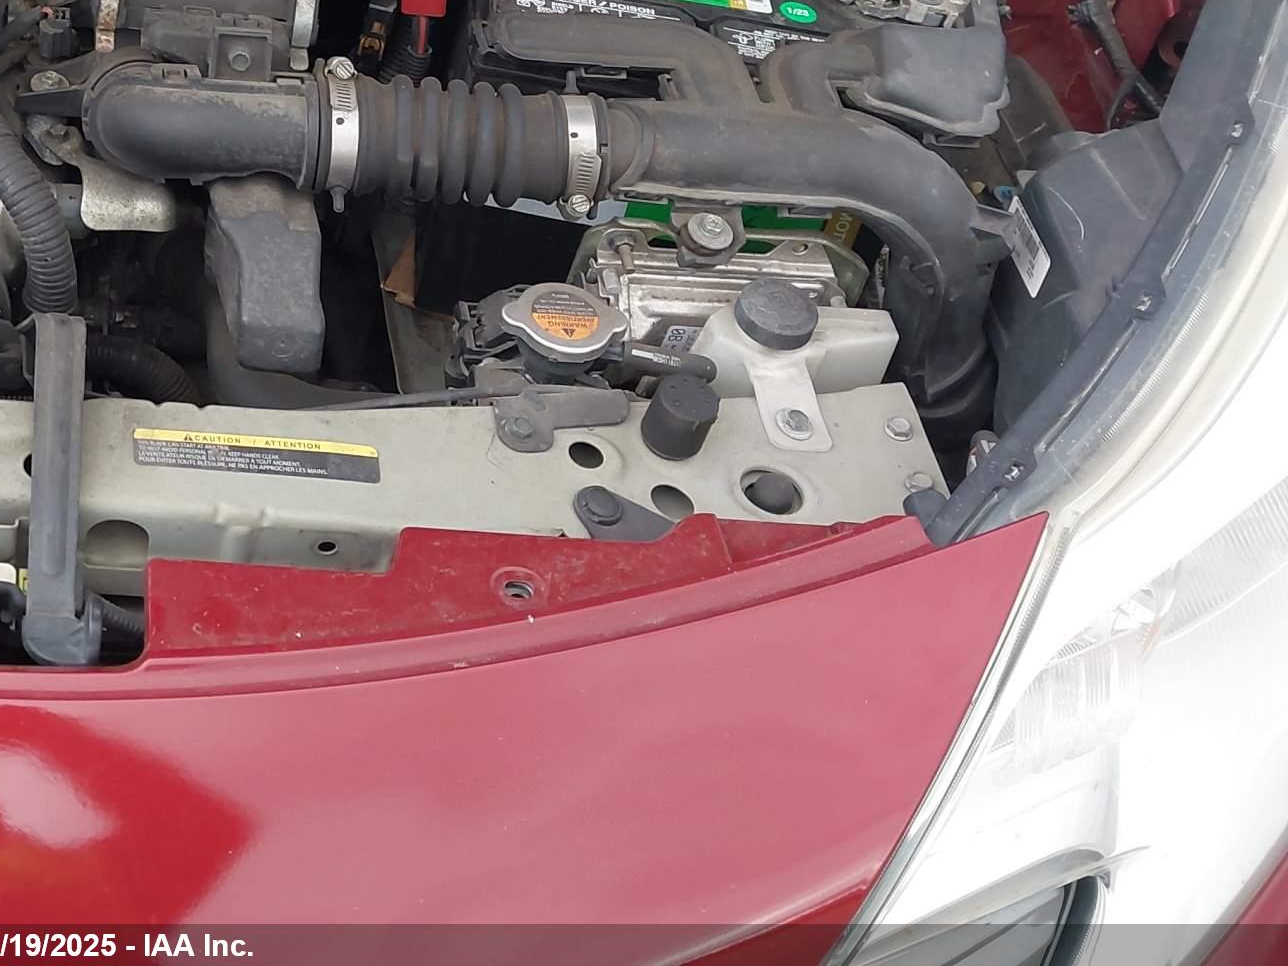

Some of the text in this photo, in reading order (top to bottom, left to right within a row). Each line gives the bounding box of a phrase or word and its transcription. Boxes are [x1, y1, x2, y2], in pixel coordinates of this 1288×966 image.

[609, 2, 655, 14] POISON
[547, 321, 588, 329] WARNING
[194, 435, 240, 443] CAUTION
[264, 439, 320, 448] ATTENTION
